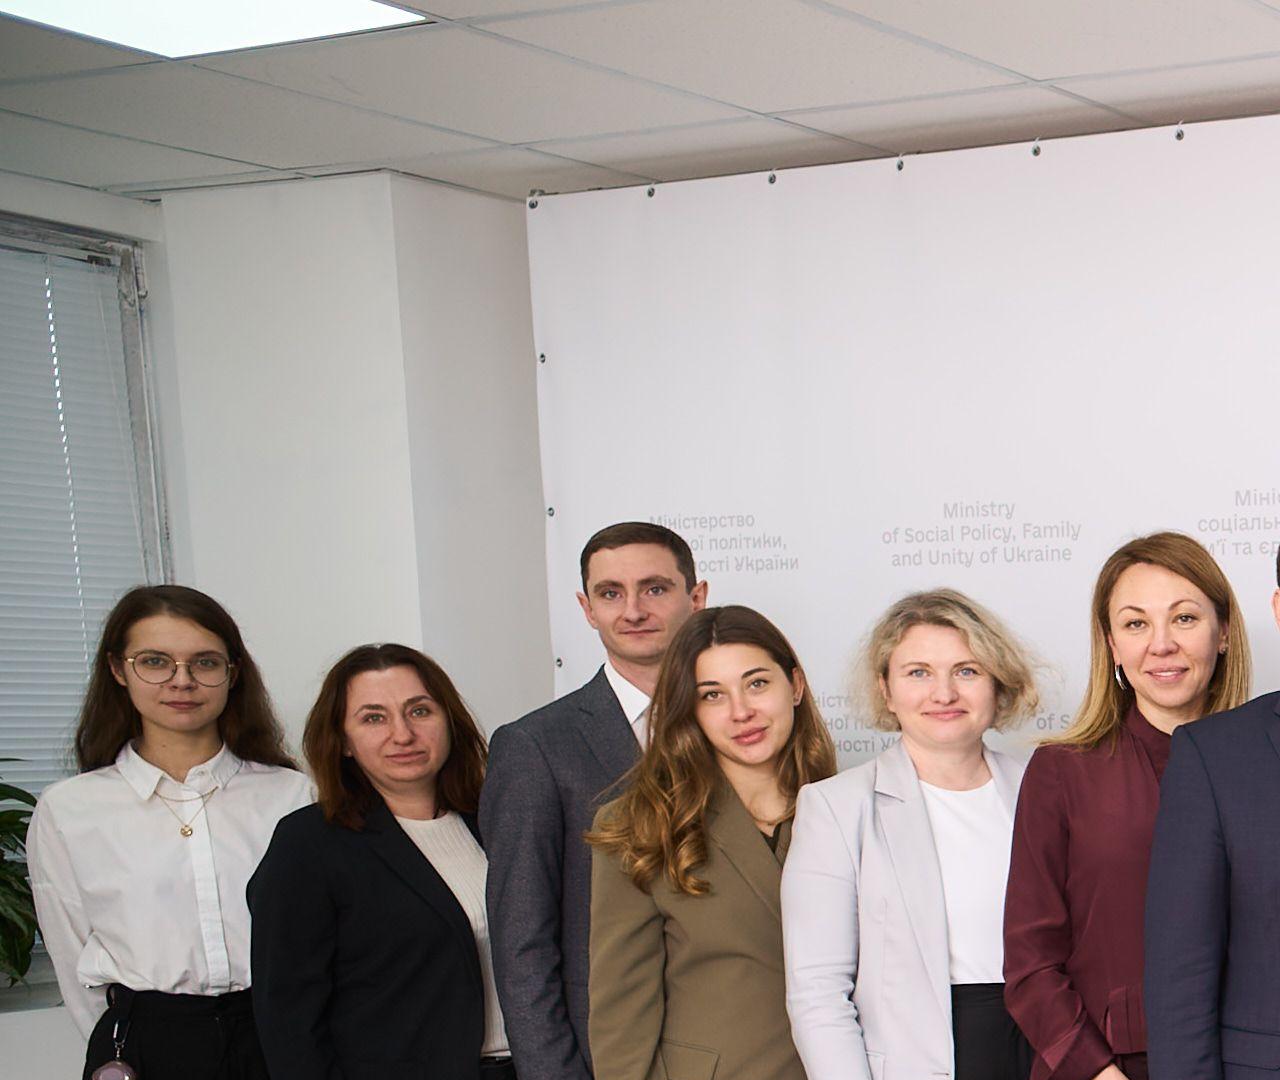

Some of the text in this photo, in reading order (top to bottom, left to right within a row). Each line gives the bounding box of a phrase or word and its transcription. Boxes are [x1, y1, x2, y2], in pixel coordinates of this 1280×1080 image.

[943, 501, 1016, 520] Ministry
[708, 533, 788, 551] політики,
[881, 520, 1082, 545] of Social Policy, Family
[891, 545, 1073, 568] and Unity of Ukraine
[1232, 539, 1253, 556] та
[695, 554, 800, 574] ості України
[1036, 713, 1056, 730] of
